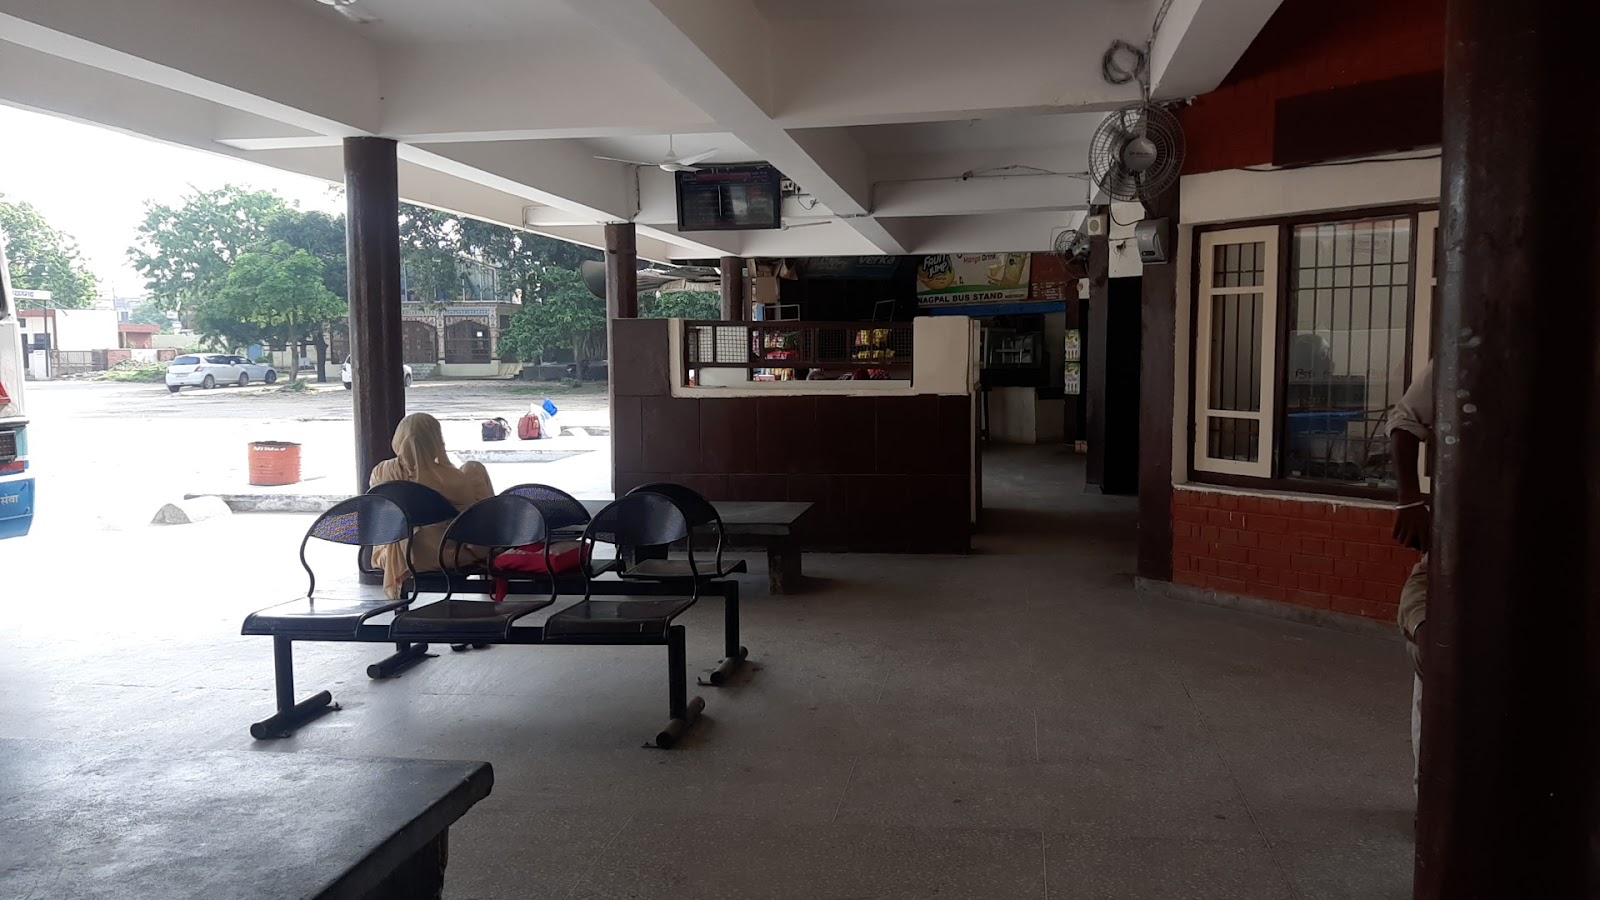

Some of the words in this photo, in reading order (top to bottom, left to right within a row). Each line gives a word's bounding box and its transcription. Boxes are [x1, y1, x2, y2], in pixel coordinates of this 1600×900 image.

[963, 256, 981, 264] Mango
[928, 261, 948, 278] JUMP
[917, 296, 950, 304] NAGPAL
[953, 294, 970, 302] BUS
[973, 292, 1003, 301] STAND
